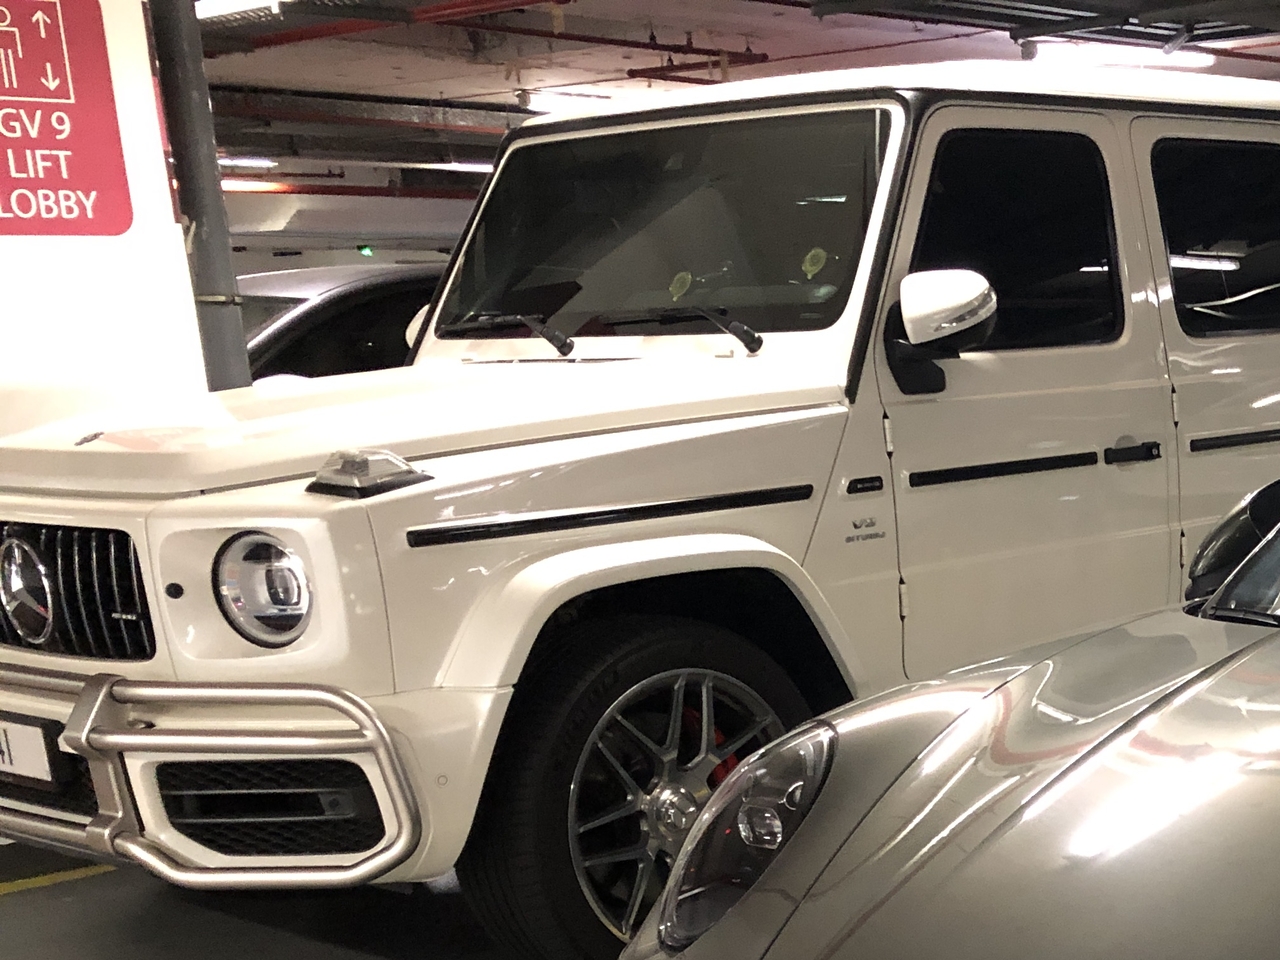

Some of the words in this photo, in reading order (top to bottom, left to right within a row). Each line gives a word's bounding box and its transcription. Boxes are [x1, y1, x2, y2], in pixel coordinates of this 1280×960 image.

[0, 108, 42, 138] GV
[51, 112, 71, 139] 9
[7, 149, 72, 179] LIFT
